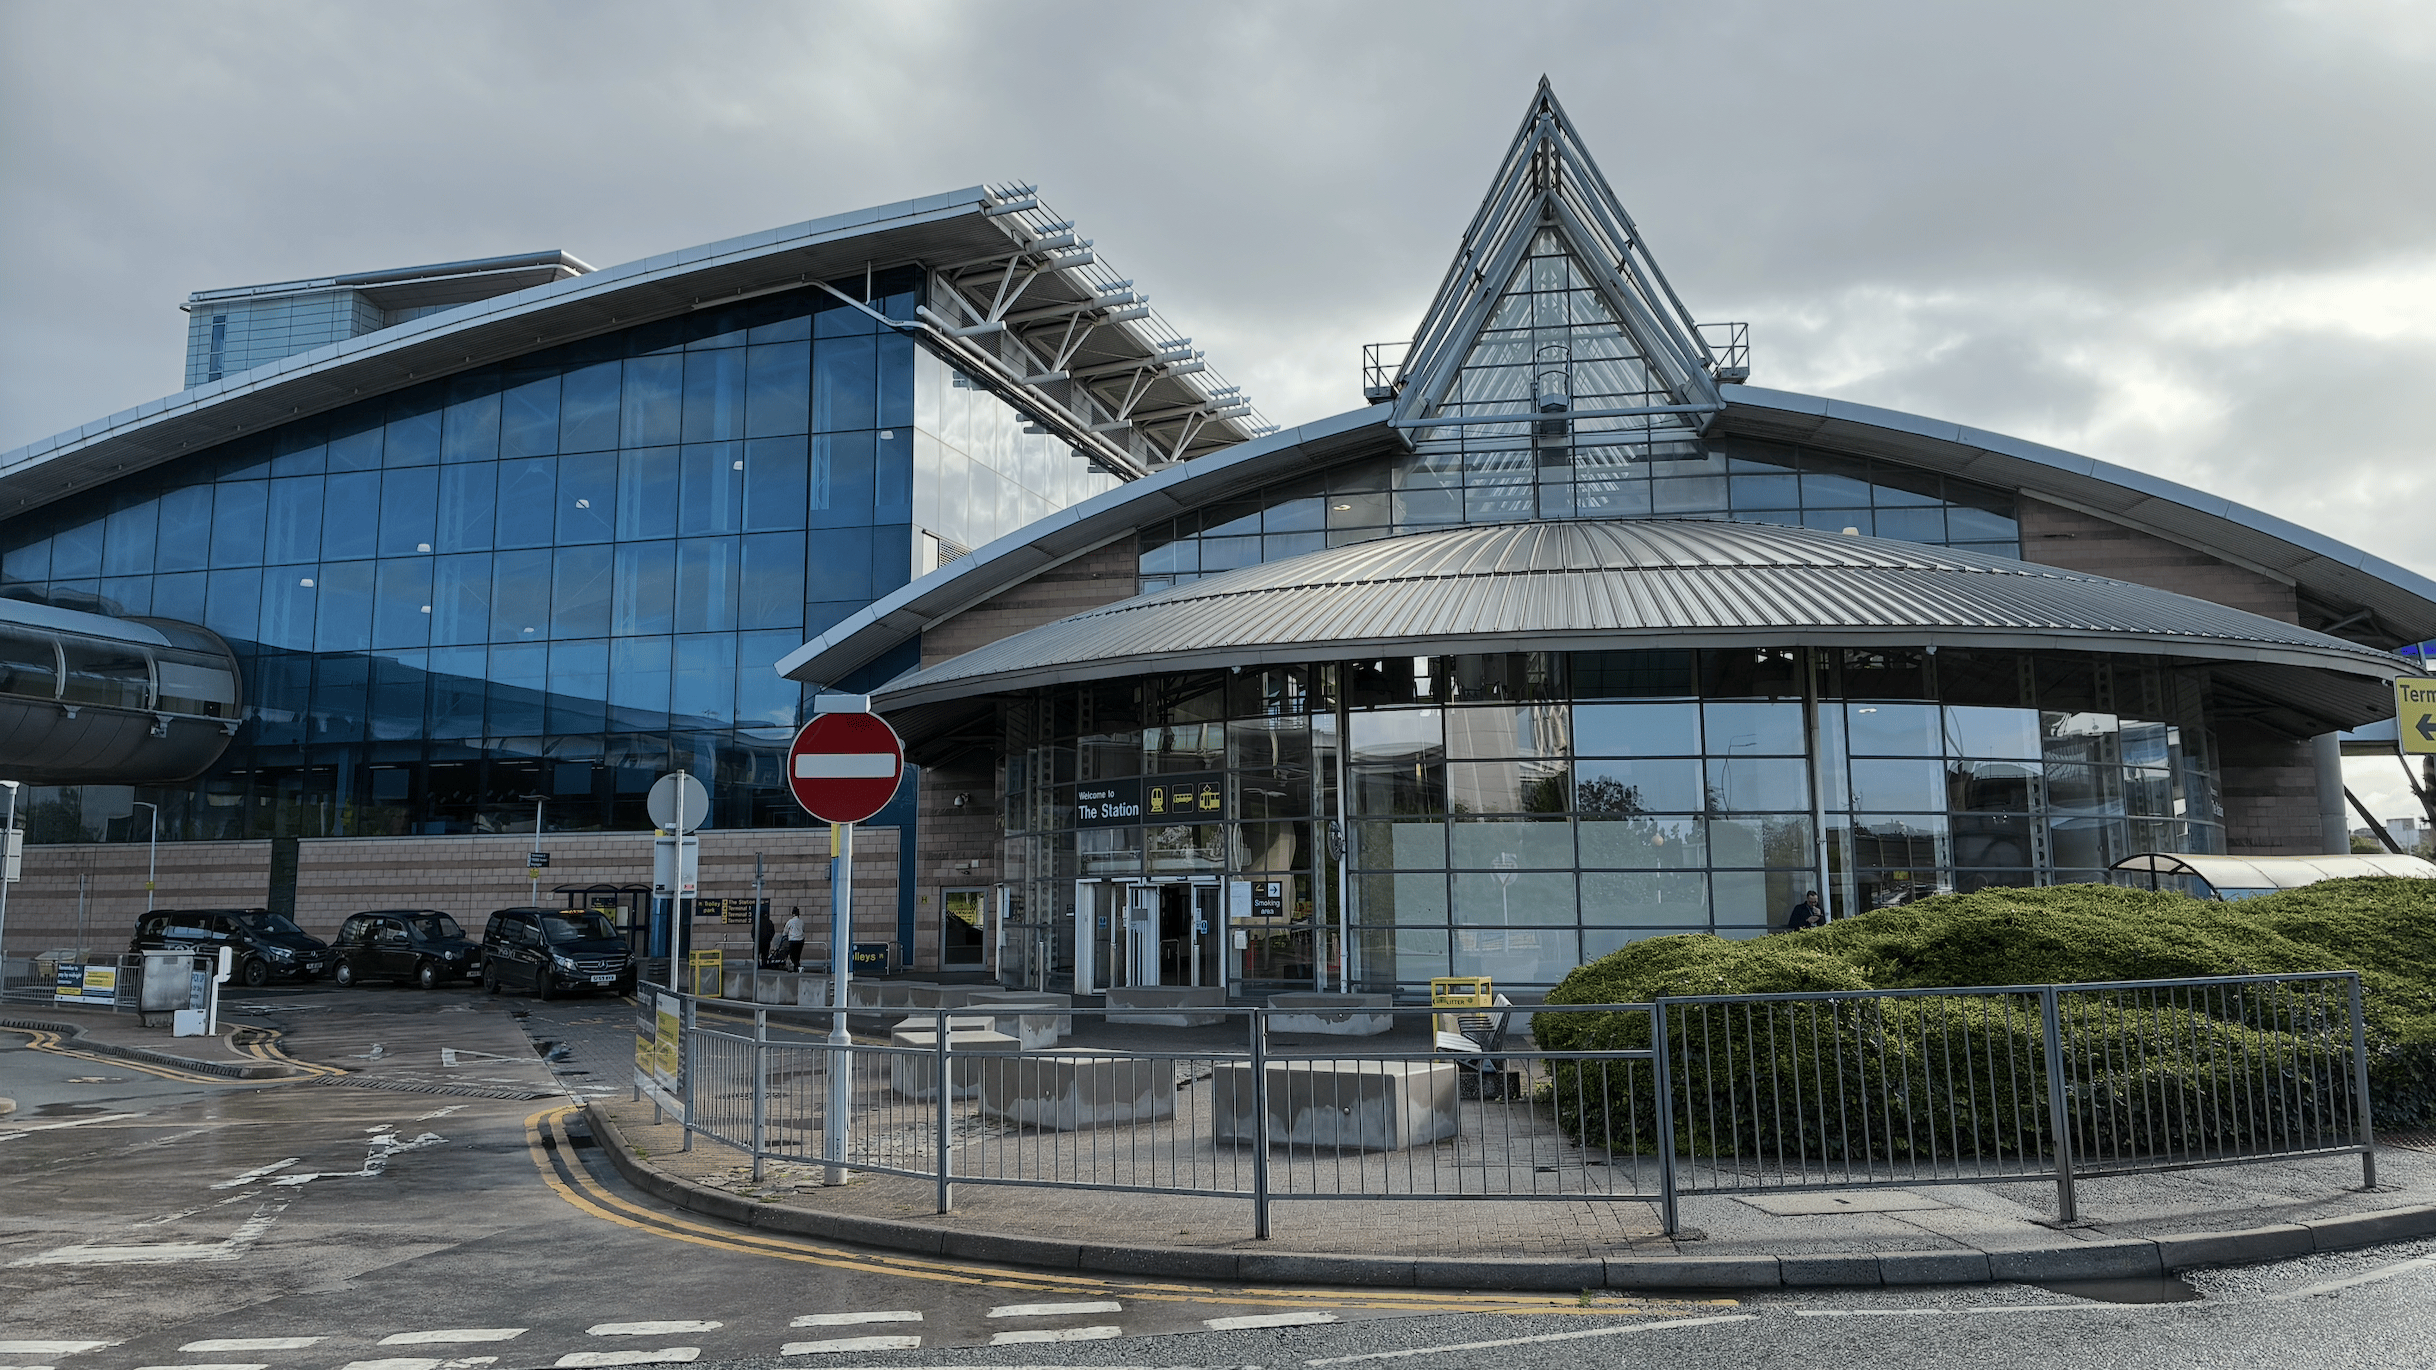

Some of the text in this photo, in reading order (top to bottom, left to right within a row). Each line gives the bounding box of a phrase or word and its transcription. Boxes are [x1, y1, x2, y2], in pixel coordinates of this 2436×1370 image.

[2400, 685, 2436, 702] Term
[1078, 789, 1115, 800] Welcome to
[1078, 802, 1139, 819] The Station
[705, 900, 721, 908] Trolley
[1254, 899, 1281, 908] Smoking
